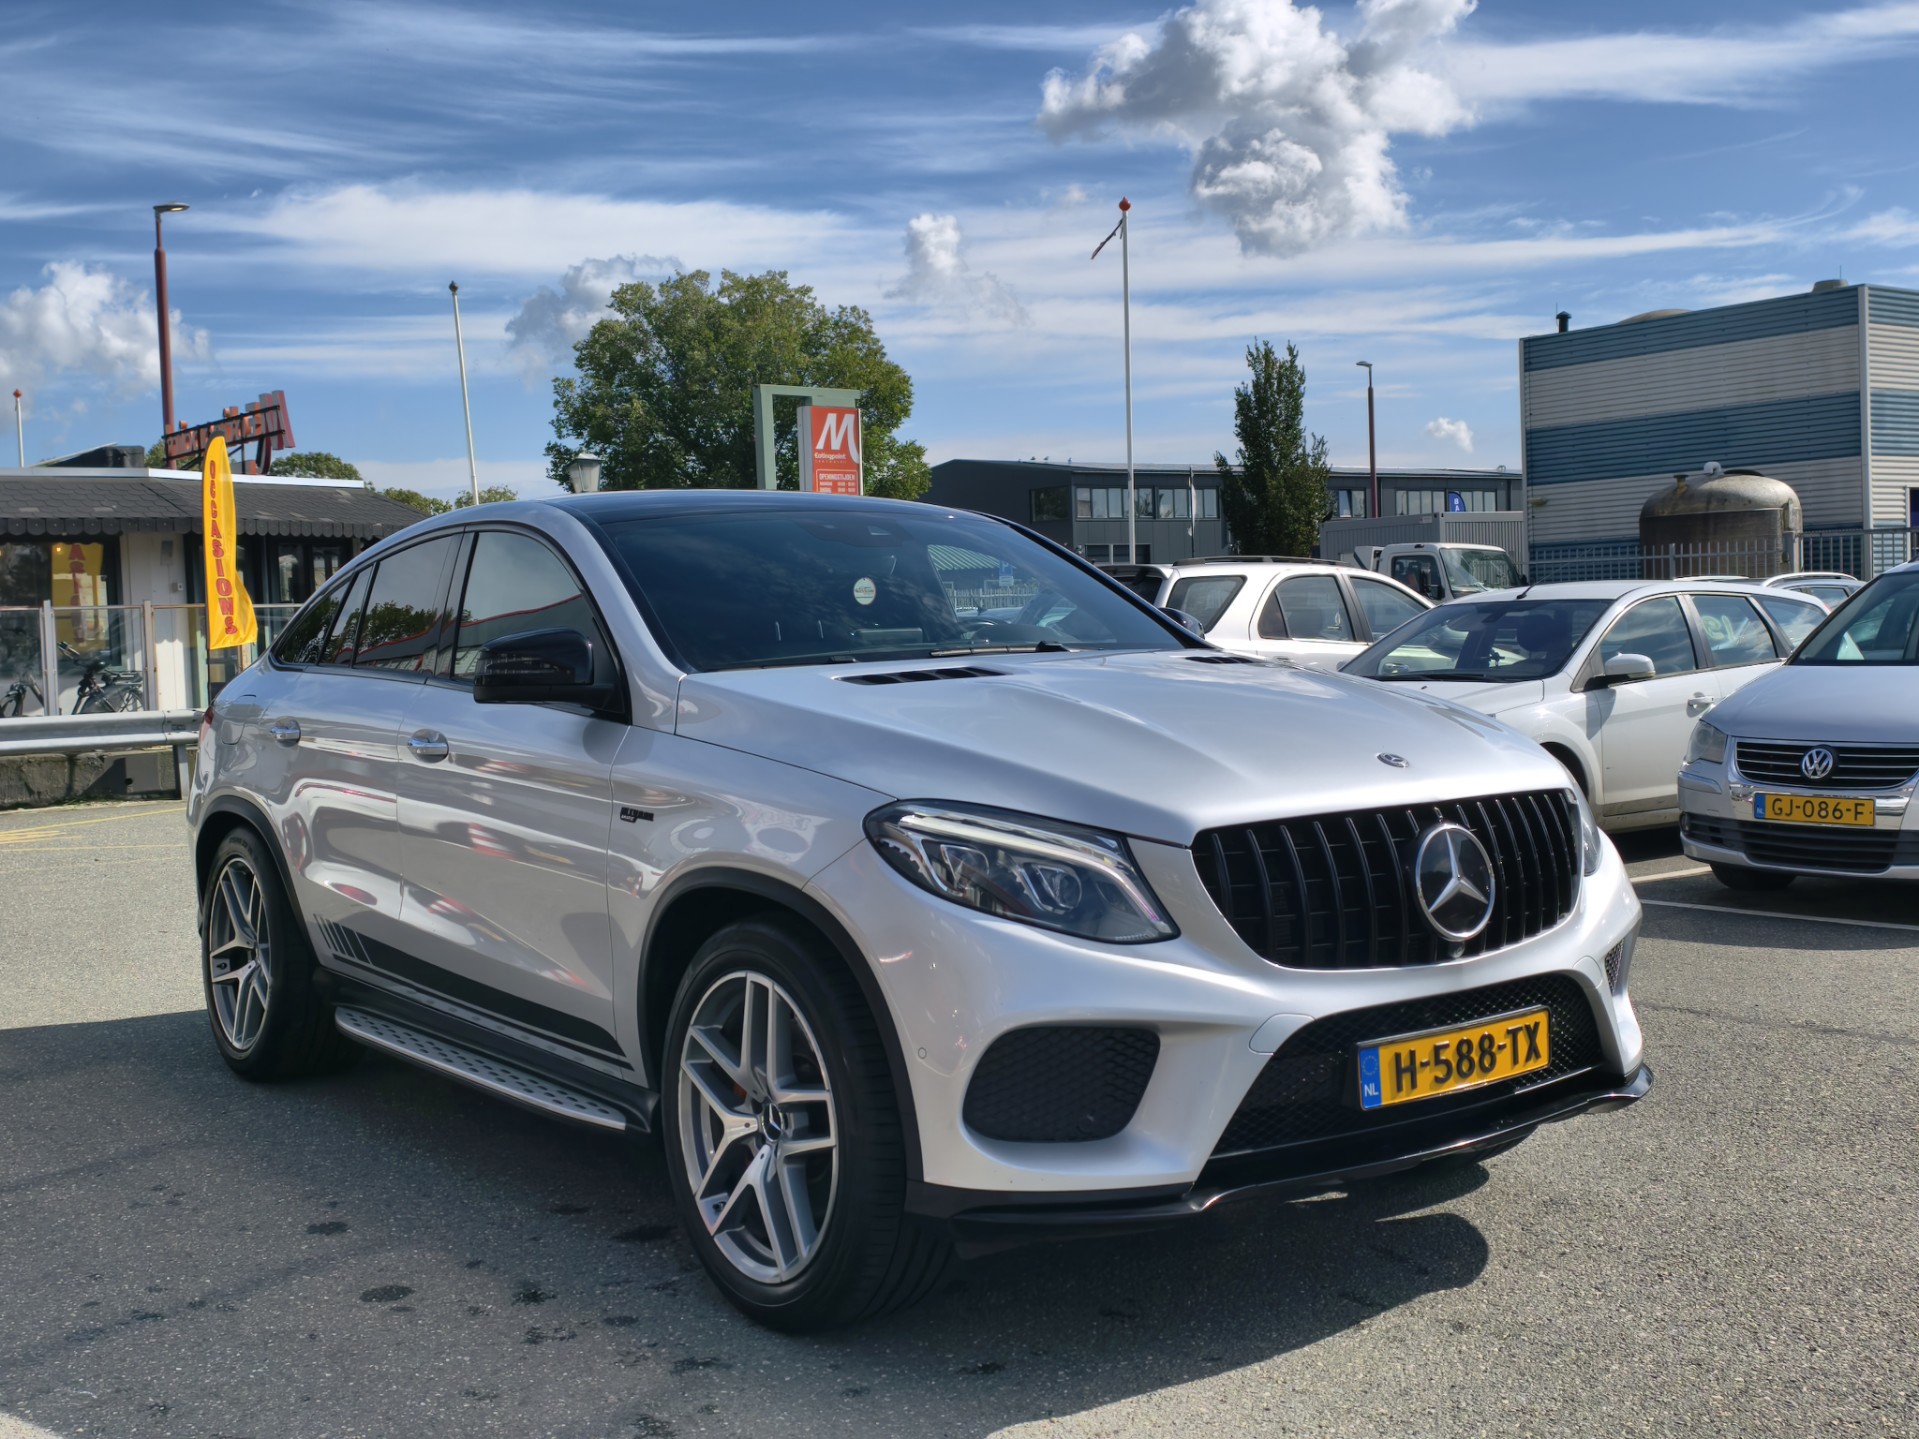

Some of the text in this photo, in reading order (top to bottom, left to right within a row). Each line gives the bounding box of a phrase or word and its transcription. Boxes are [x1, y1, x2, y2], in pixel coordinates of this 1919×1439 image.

[210, 460, 237, 635] OCCASIONS
[1771, 797, 1866, 821] GJ-086-F
[1394, 1021, 1541, 1093] H-588-TX
[1364, 1083, 1379, 1097] NL
